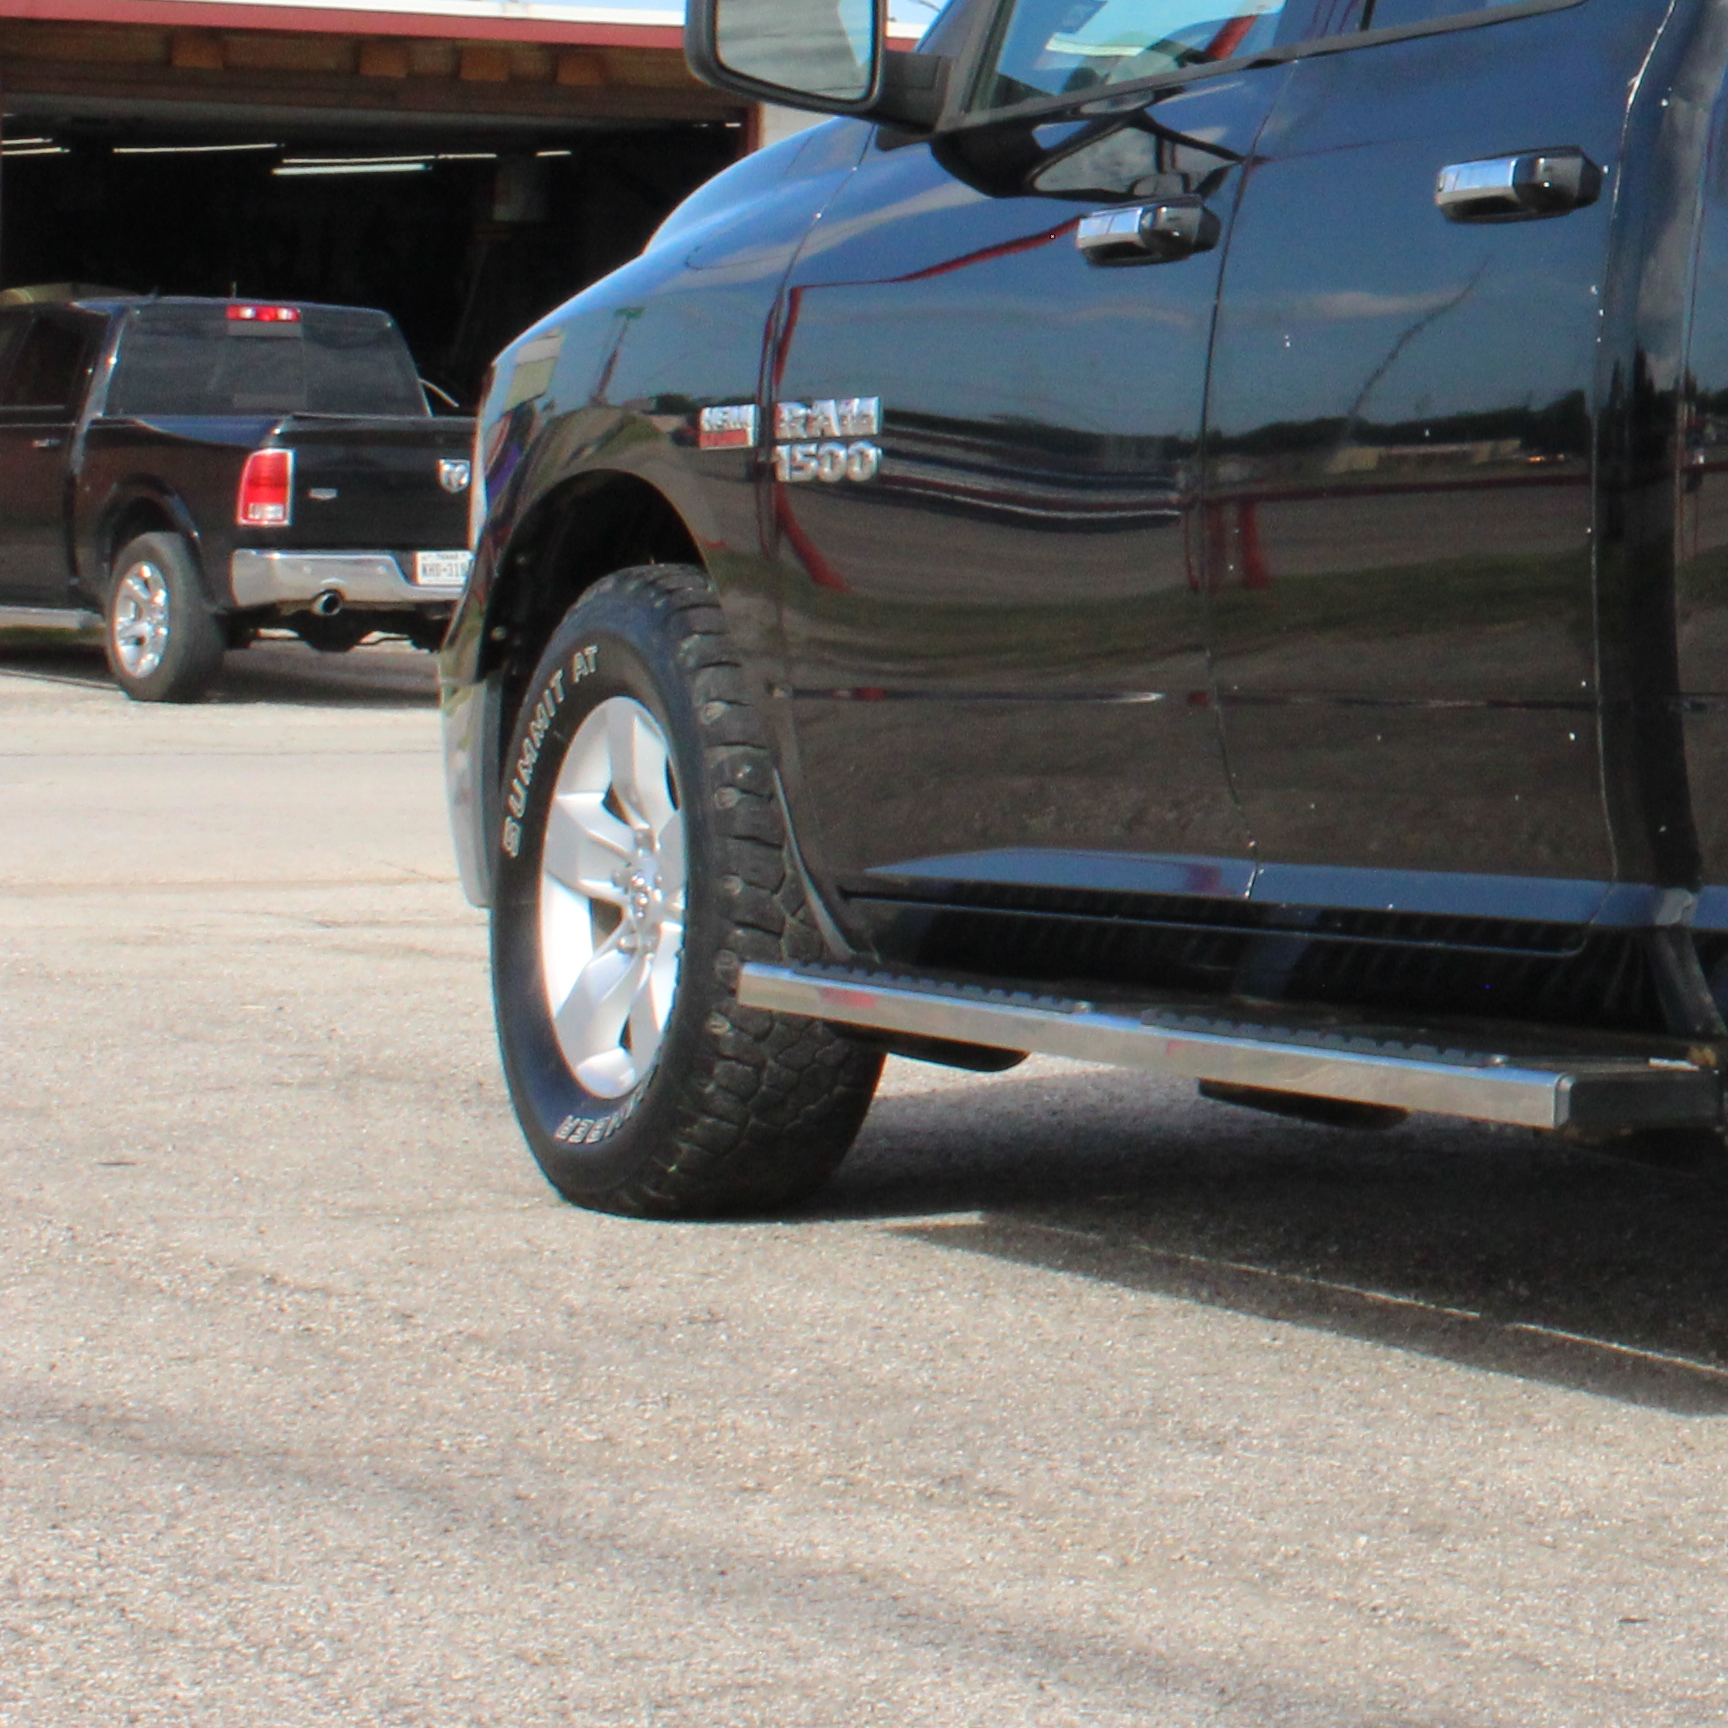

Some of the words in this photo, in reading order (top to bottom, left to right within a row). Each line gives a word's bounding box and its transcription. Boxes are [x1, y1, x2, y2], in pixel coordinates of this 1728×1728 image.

[774, 396, 882, 440] RAM
[772, 441, 882, 483] 1500
[502, 669, 565, 859] SUMMIT
[571, 645, 600, 684] AT
